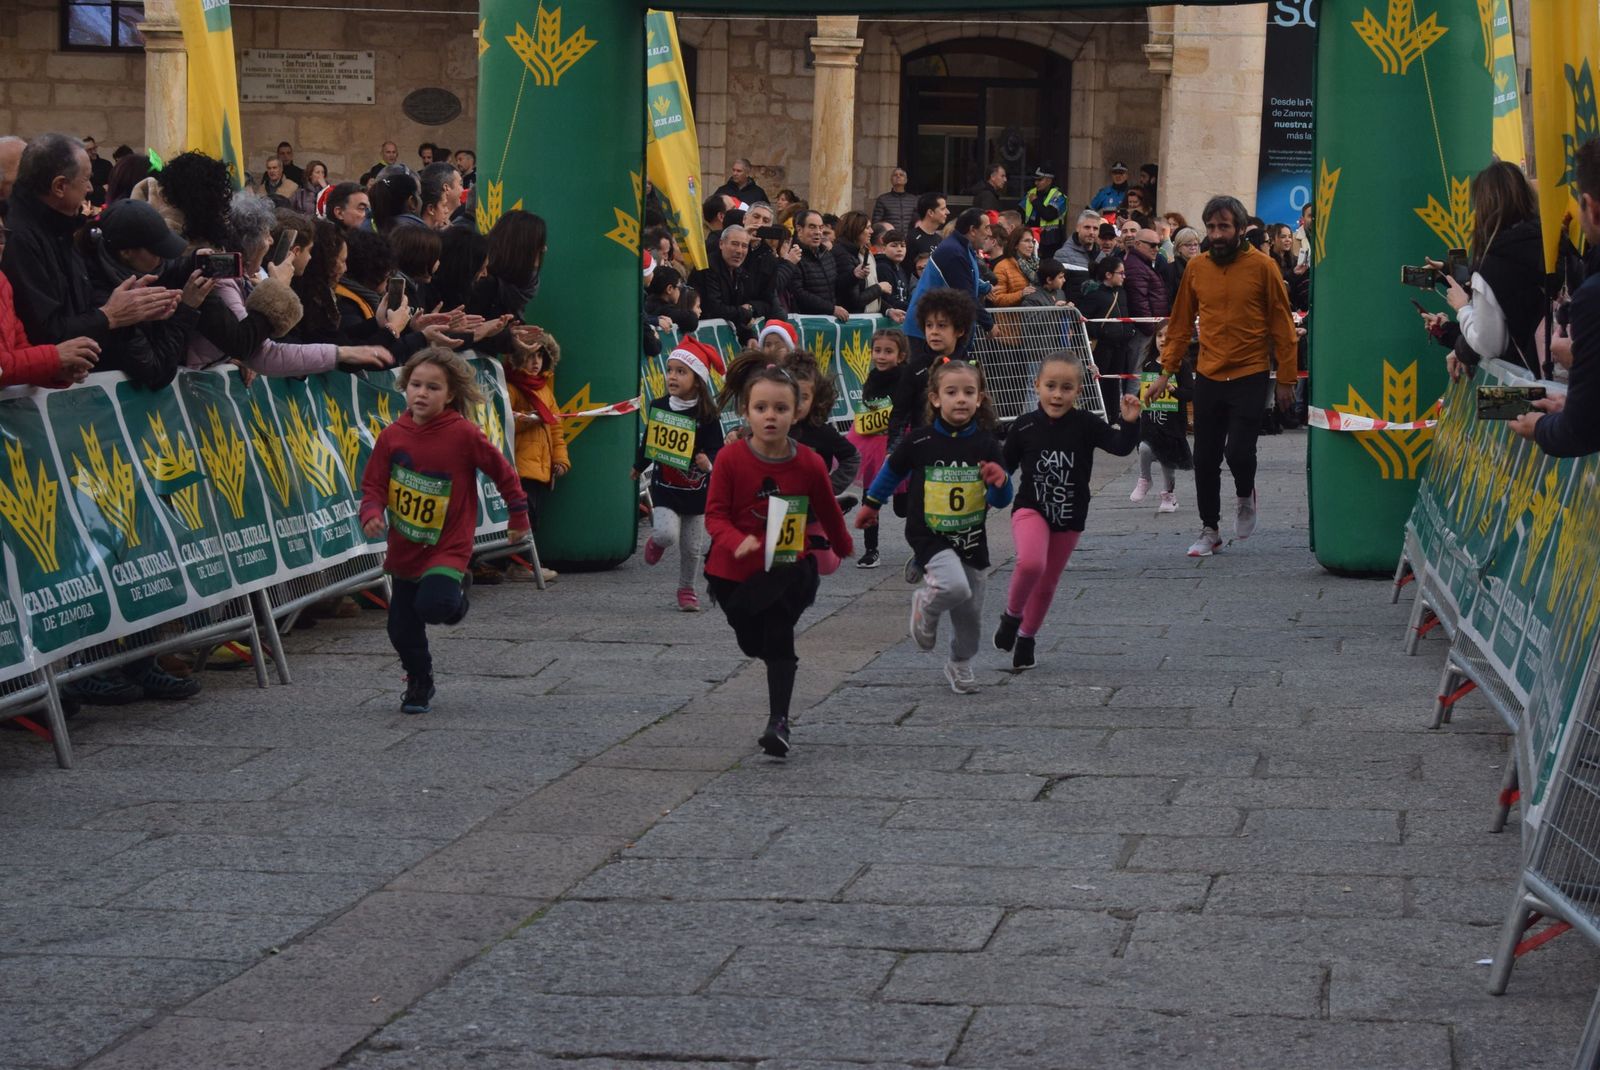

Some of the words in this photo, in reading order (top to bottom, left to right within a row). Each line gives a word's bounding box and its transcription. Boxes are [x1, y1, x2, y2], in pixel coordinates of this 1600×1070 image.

[1271, 97, 1297, 106] Desde
[1298, 98, 1304, 106] la
[1272, 109, 1283, 117] de
[1274, 121, 1307, 129] nuestra
[1286, 132, 1304, 140] más
[859, 409, 889, 433] 1308
[653, 424, 689, 453] 1398
[394, 487, 437, 524] 1318
[949, 486, 965, 512] 6
[323, 528, 335, 542] DE
[941, 519, 960, 527] CAJA
[224, 530, 244, 553] CAJA
[240, 523, 271, 548] RURAL
[111, 560, 142, 587] CAJA
[137, 549, 177, 578] RURAL
[243, 548, 268, 565] ZAMORA
[23, 586, 60, 616] CAJA
[55, 573, 104, 605] RURAL
[130, 586, 144, 602] DE
[142, 576, 174, 597] ZAMORA
[42, 614, 58, 632] DE
[57, 602, 95, 626] ZAMORA
